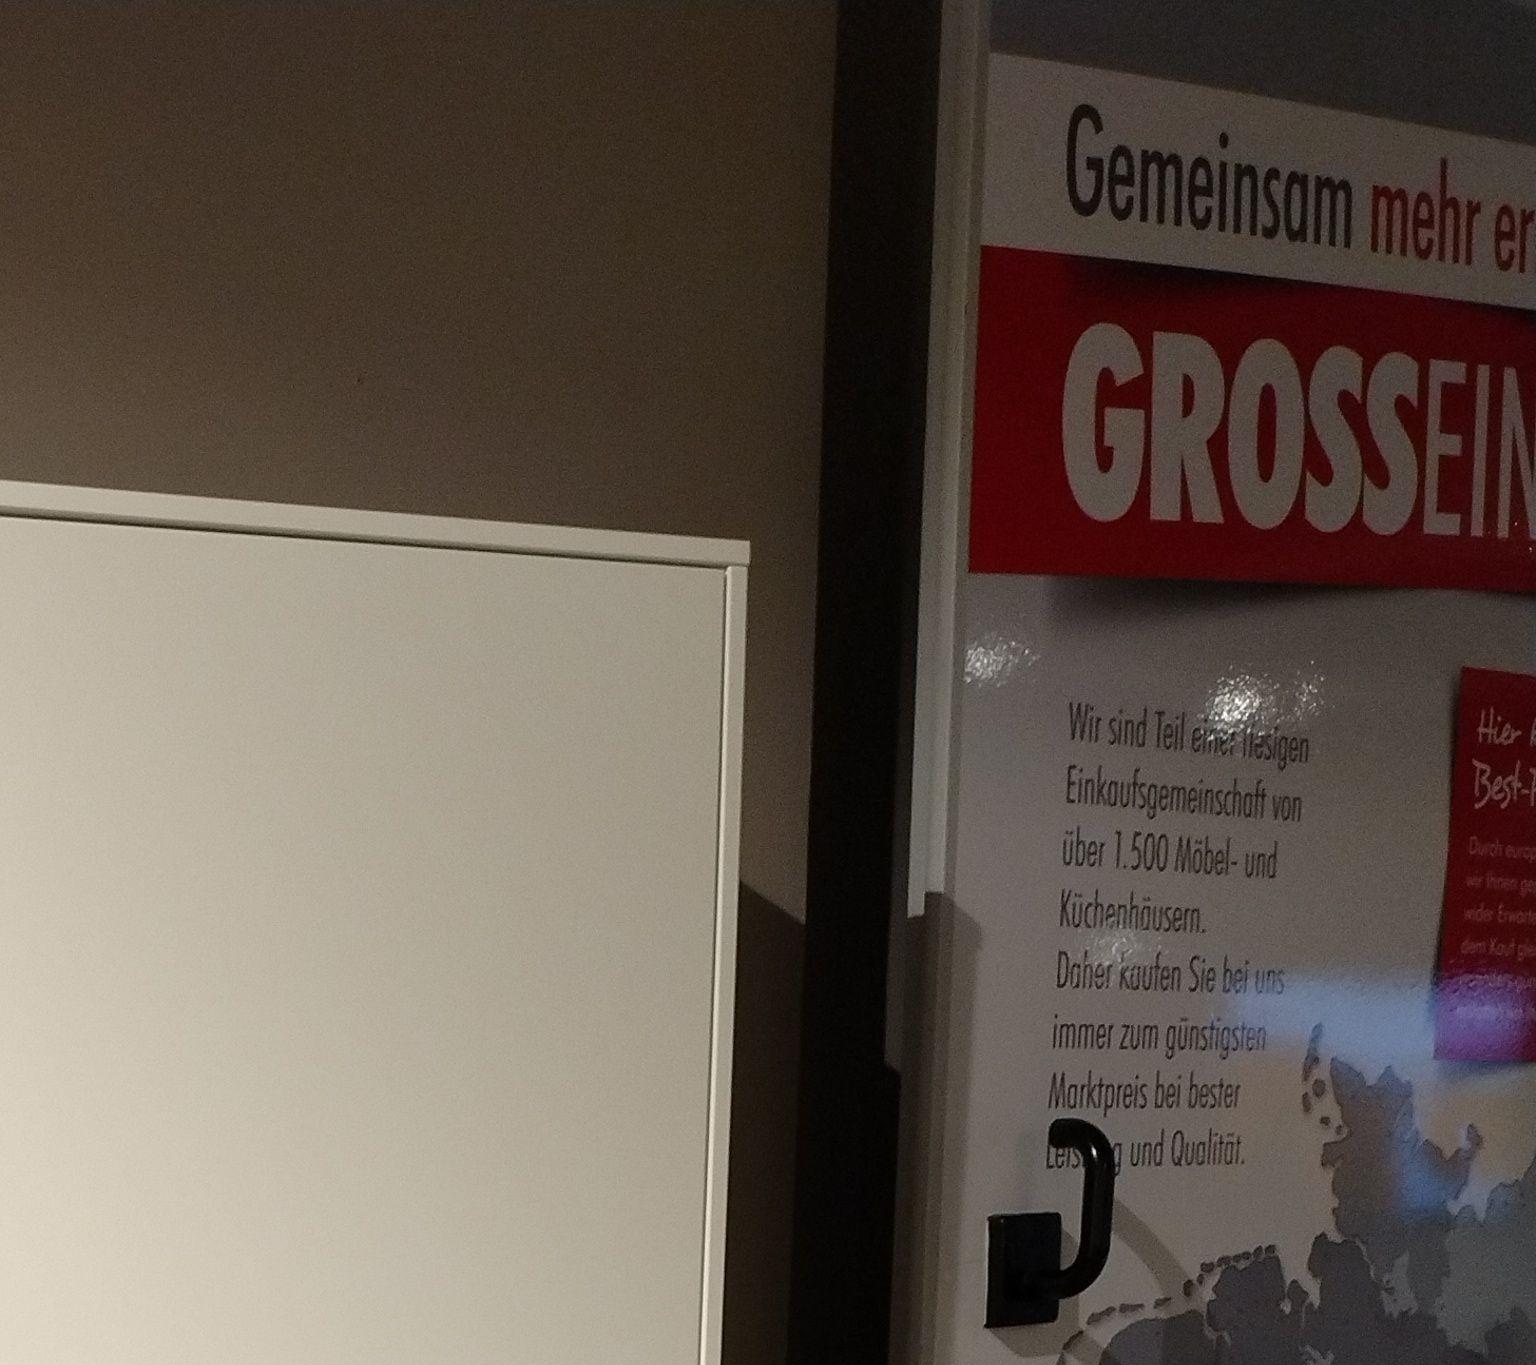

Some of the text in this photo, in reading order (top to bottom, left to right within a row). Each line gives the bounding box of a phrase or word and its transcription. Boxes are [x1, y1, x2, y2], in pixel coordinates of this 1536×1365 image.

[1065, 103, 1354, 250] Gemeinsam
[1370, 156, 1482, 267] mehr
[1068, 701, 1102, 743] Wir
[1108, 707, 1147, 748] sind
[1155, 710, 1185, 750] Teil
[1477, 706, 1522, 745] Hier
[1065, 764, 1303, 822] Einkaufsgemeinschaft von
[1062, 825, 1278, 879] über 1.500 Möbel- und
[1059, 887, 1206, 935] Küchenhäusern.
[1055, 950, 1285, 995] Daher kaufen Sie bei uns
[1051, 1014, 1268, 1060] immer zum günstigsten
[1047, 1070, 1241, 1117] Marktpreis bei bester
[1129, 1129, 1165, 1168] und
[1171, 1128, 1246, 1168] Qualität.
